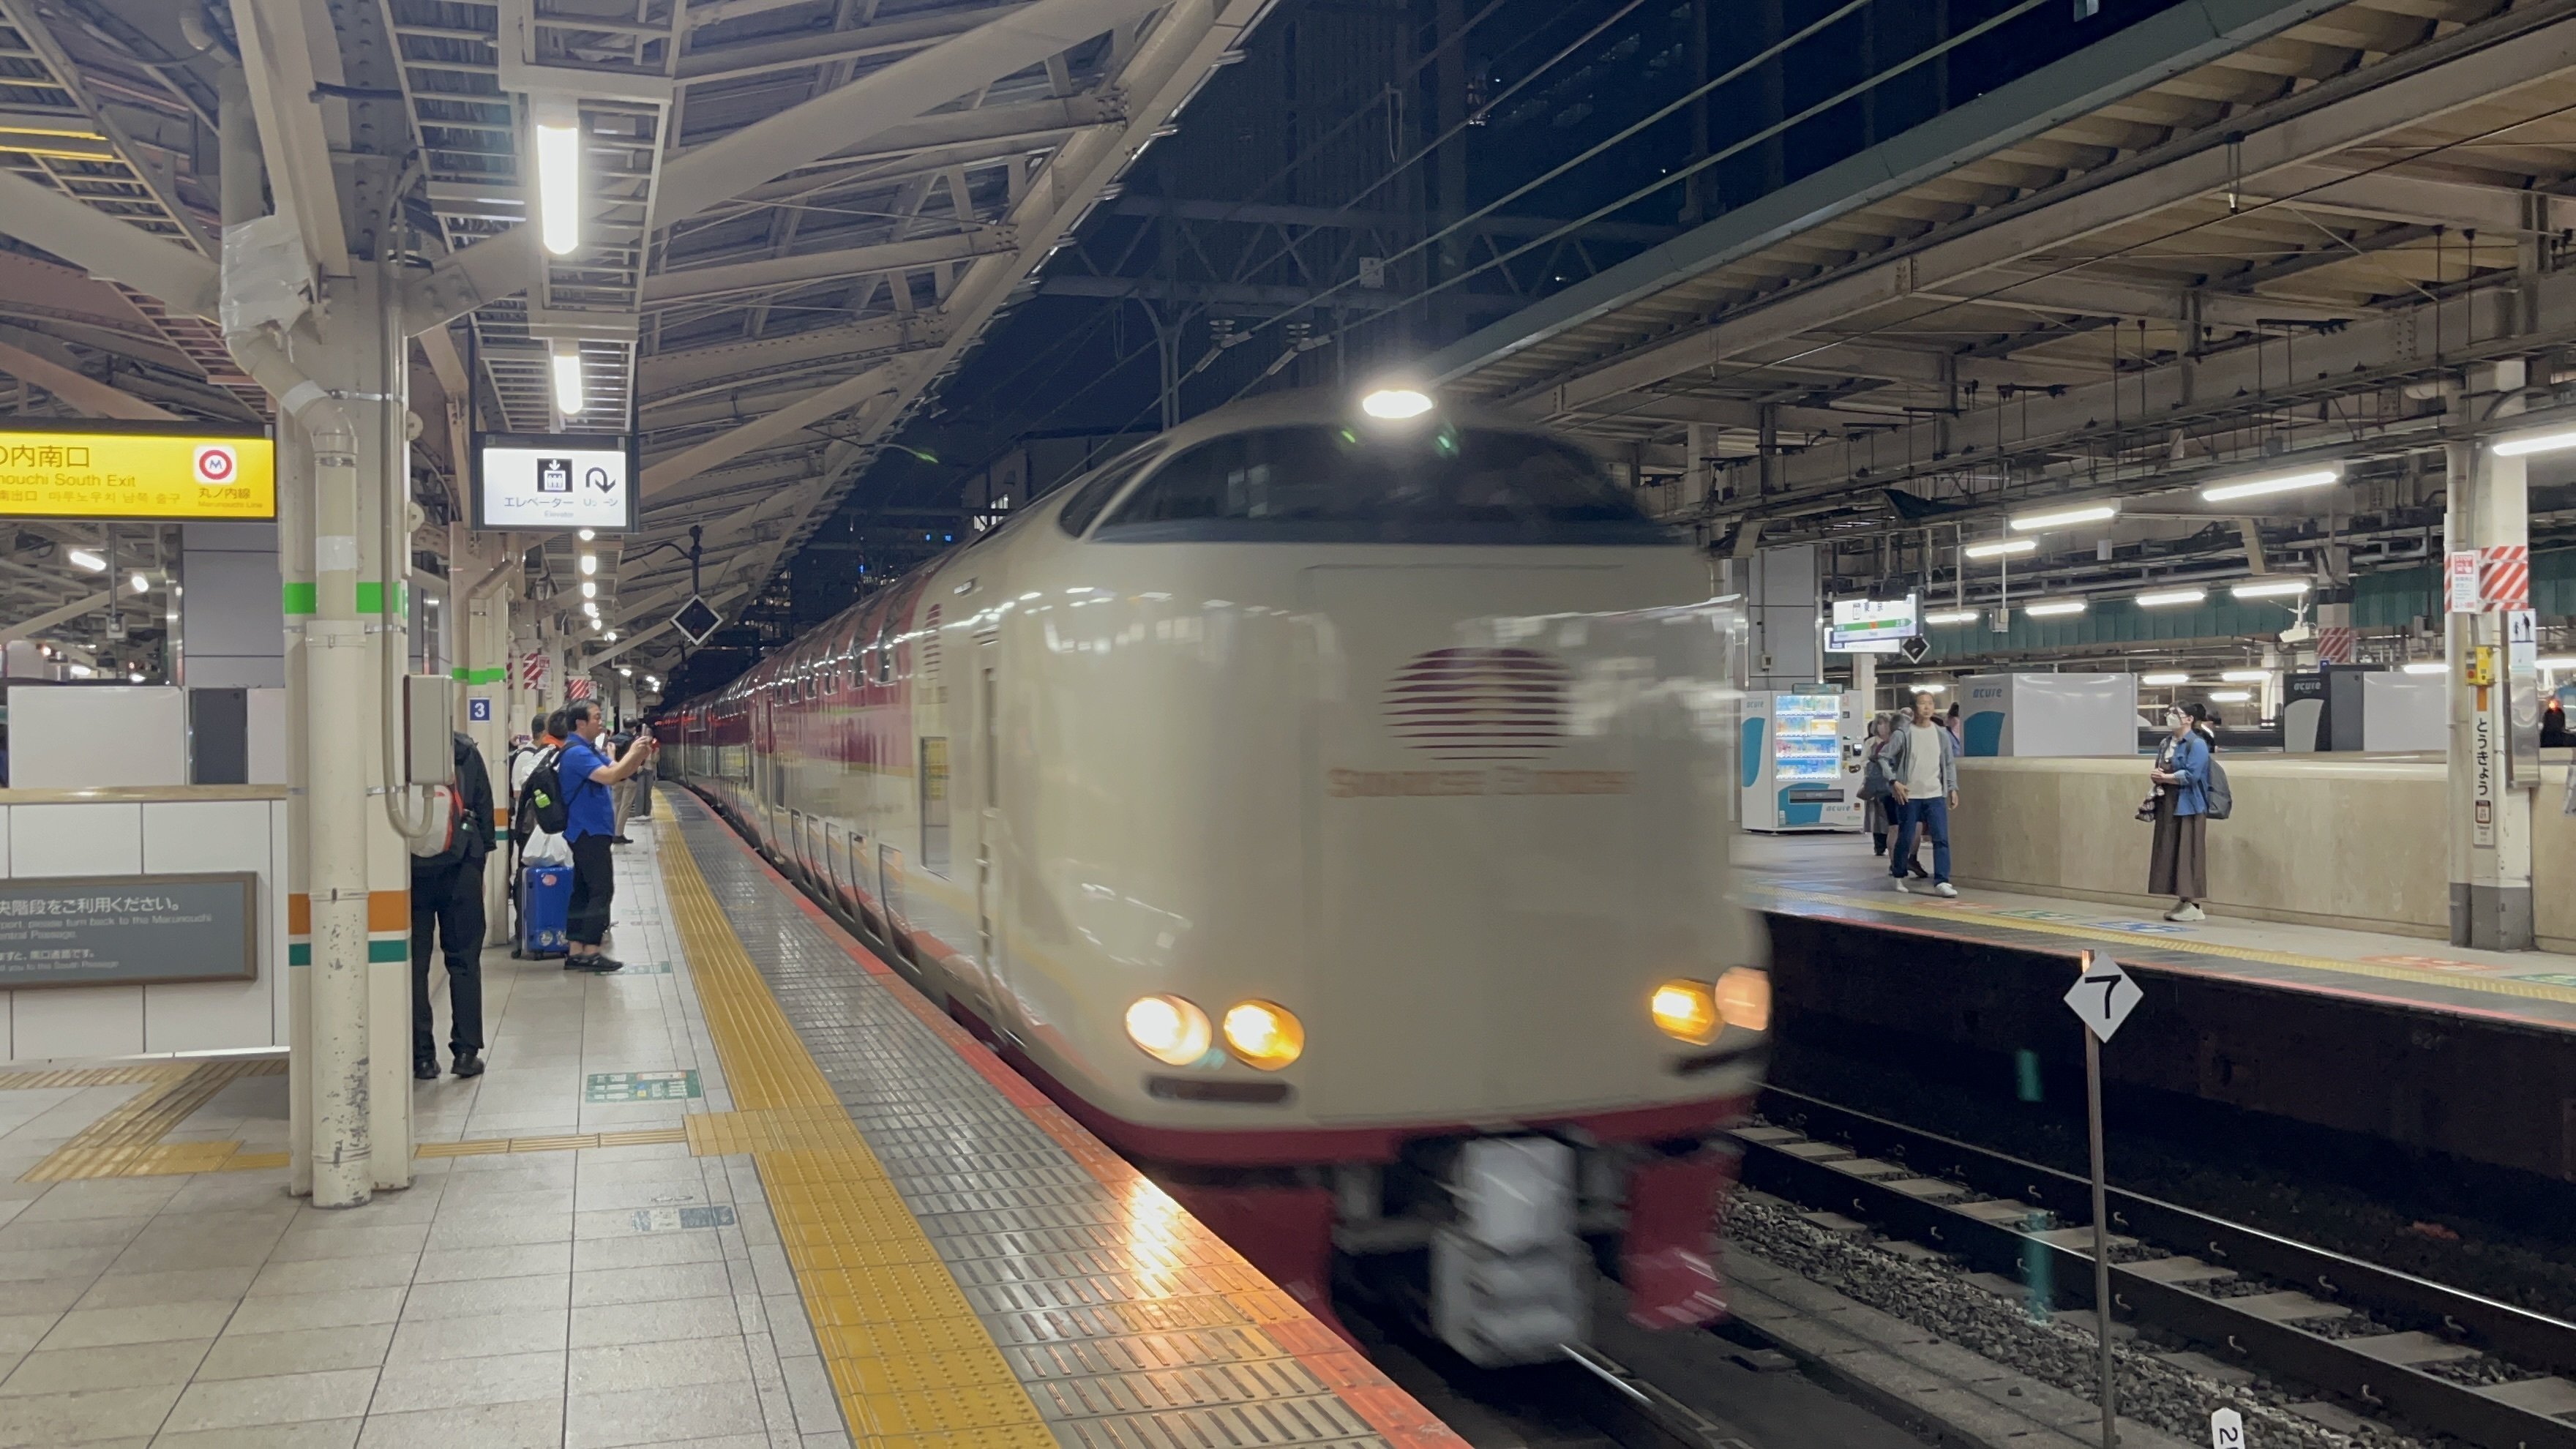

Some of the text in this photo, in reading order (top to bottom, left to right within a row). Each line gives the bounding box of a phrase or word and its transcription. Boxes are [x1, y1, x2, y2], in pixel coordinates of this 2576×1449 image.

[209, 460, 222, 469] M
[55, 473, 101, 486] South
[108, 474, 135, 487] Exit
[198, 487, 251, 499] 丸ノ内線
[504, 497, 574, 508] エレベーター
[1973, 688, 2002, 698] acure
[2294, 682, 2321, 691] acure
[474, 702, 485, 718] 3
[2476, 717, 2488, 796] とうきょう
[2084, 974, 2122, 1019] 7
[2219, 1426, 2239, 1449] 2
